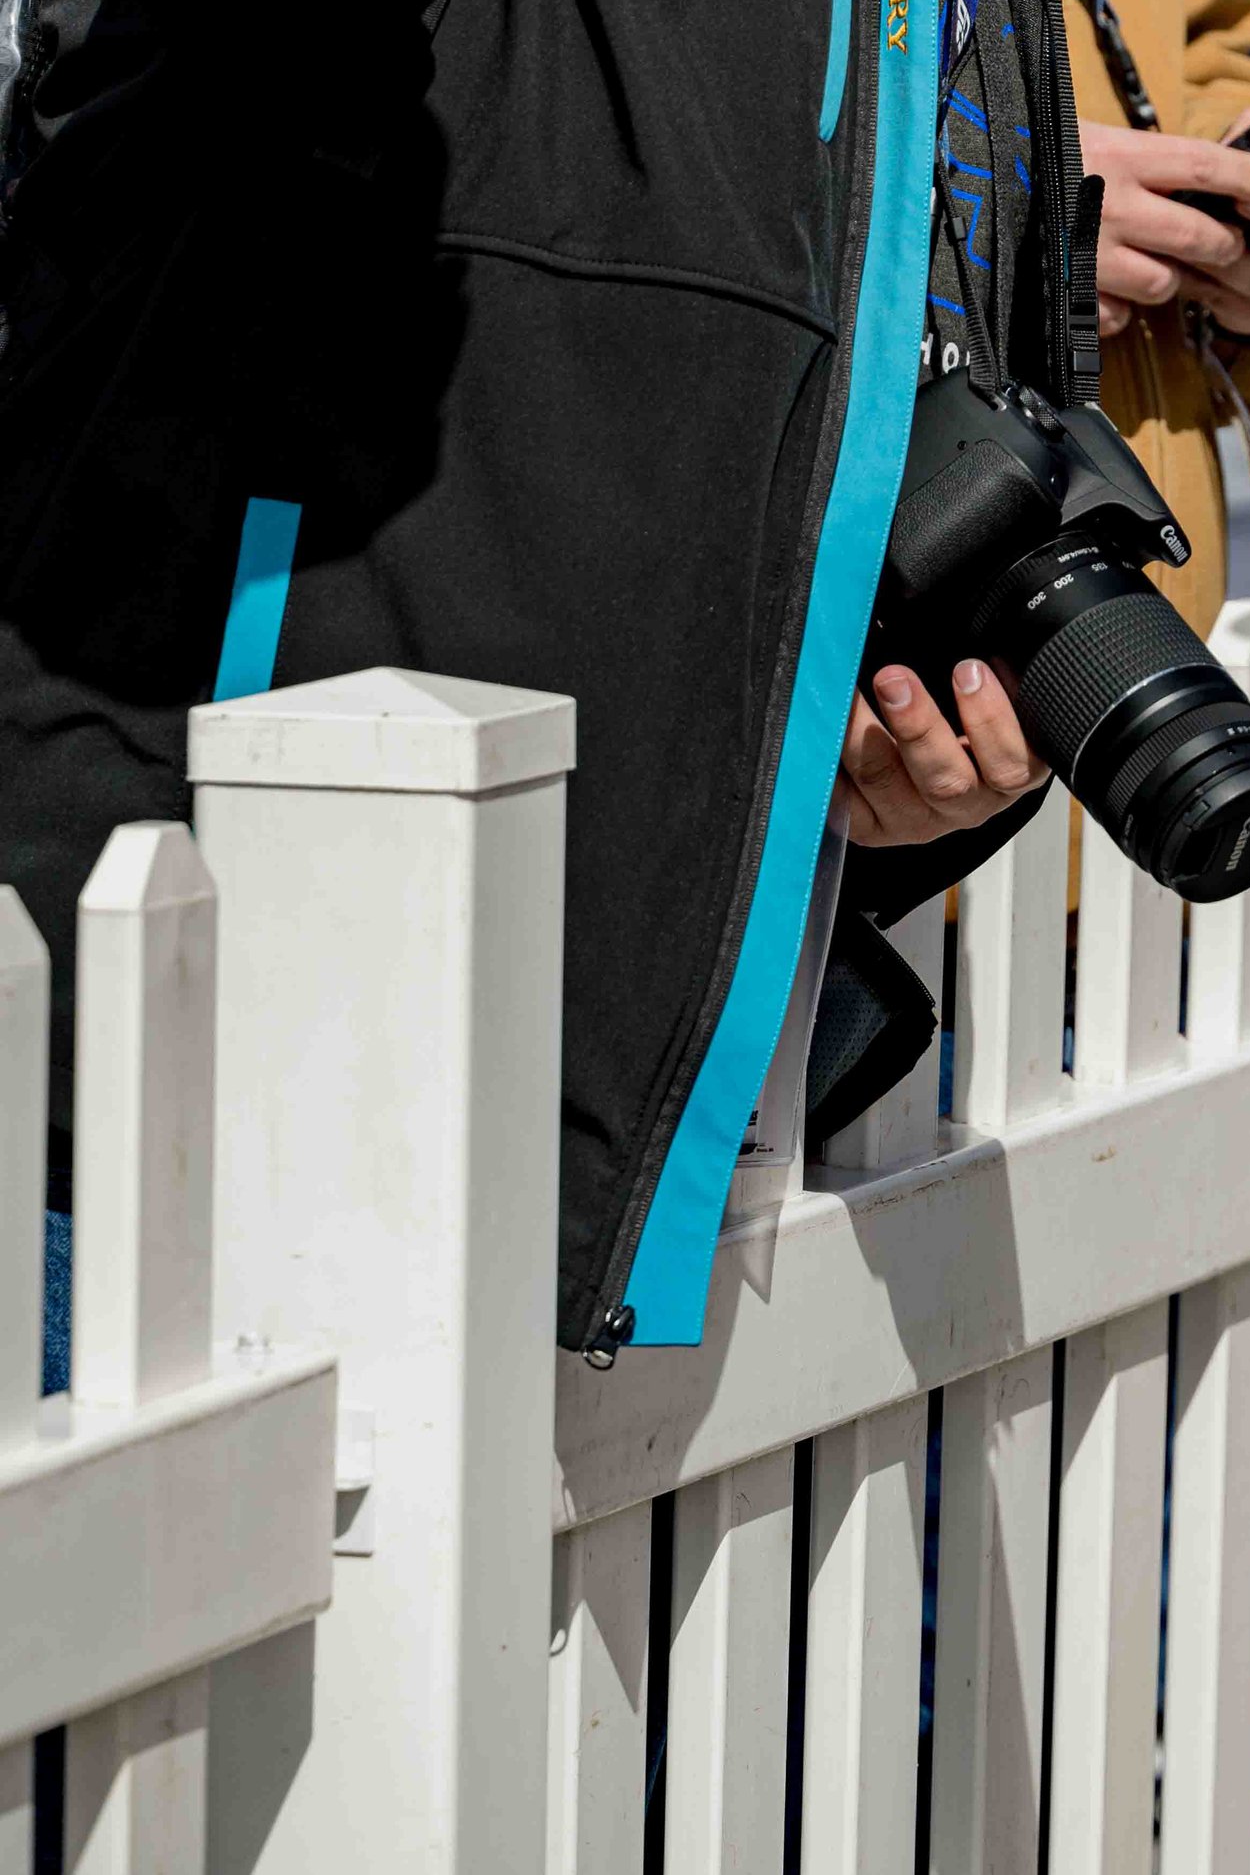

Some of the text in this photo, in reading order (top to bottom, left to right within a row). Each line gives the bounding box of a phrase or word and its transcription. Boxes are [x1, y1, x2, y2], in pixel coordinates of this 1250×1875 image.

[1160, 524, 1189, 563] Canon
[1027, 591, 1047, 610] 300
[1053, 573, 1075, 590] 200
[1091, 561, 1109, 572] 135
